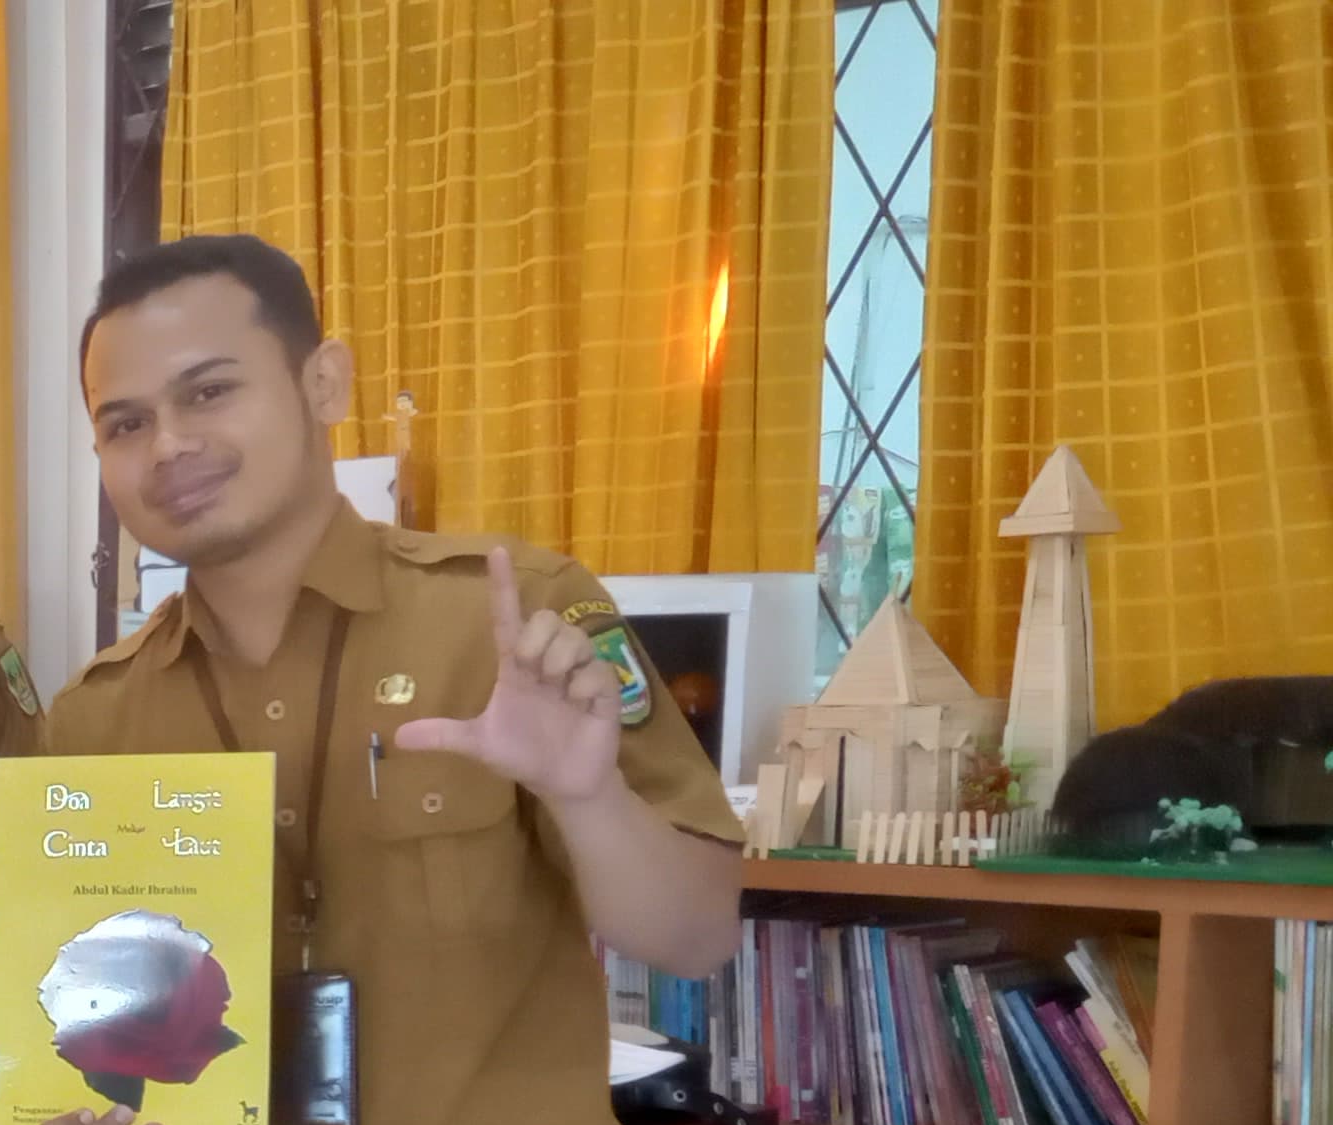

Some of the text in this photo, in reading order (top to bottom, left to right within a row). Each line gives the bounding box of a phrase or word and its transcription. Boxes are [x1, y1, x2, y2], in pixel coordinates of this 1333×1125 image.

[45, 783, 91, 812] Doa
[43, 830, 109, 858] Cinta
[73, 884, 197, 896] Abdul Kadir Ibrahim
